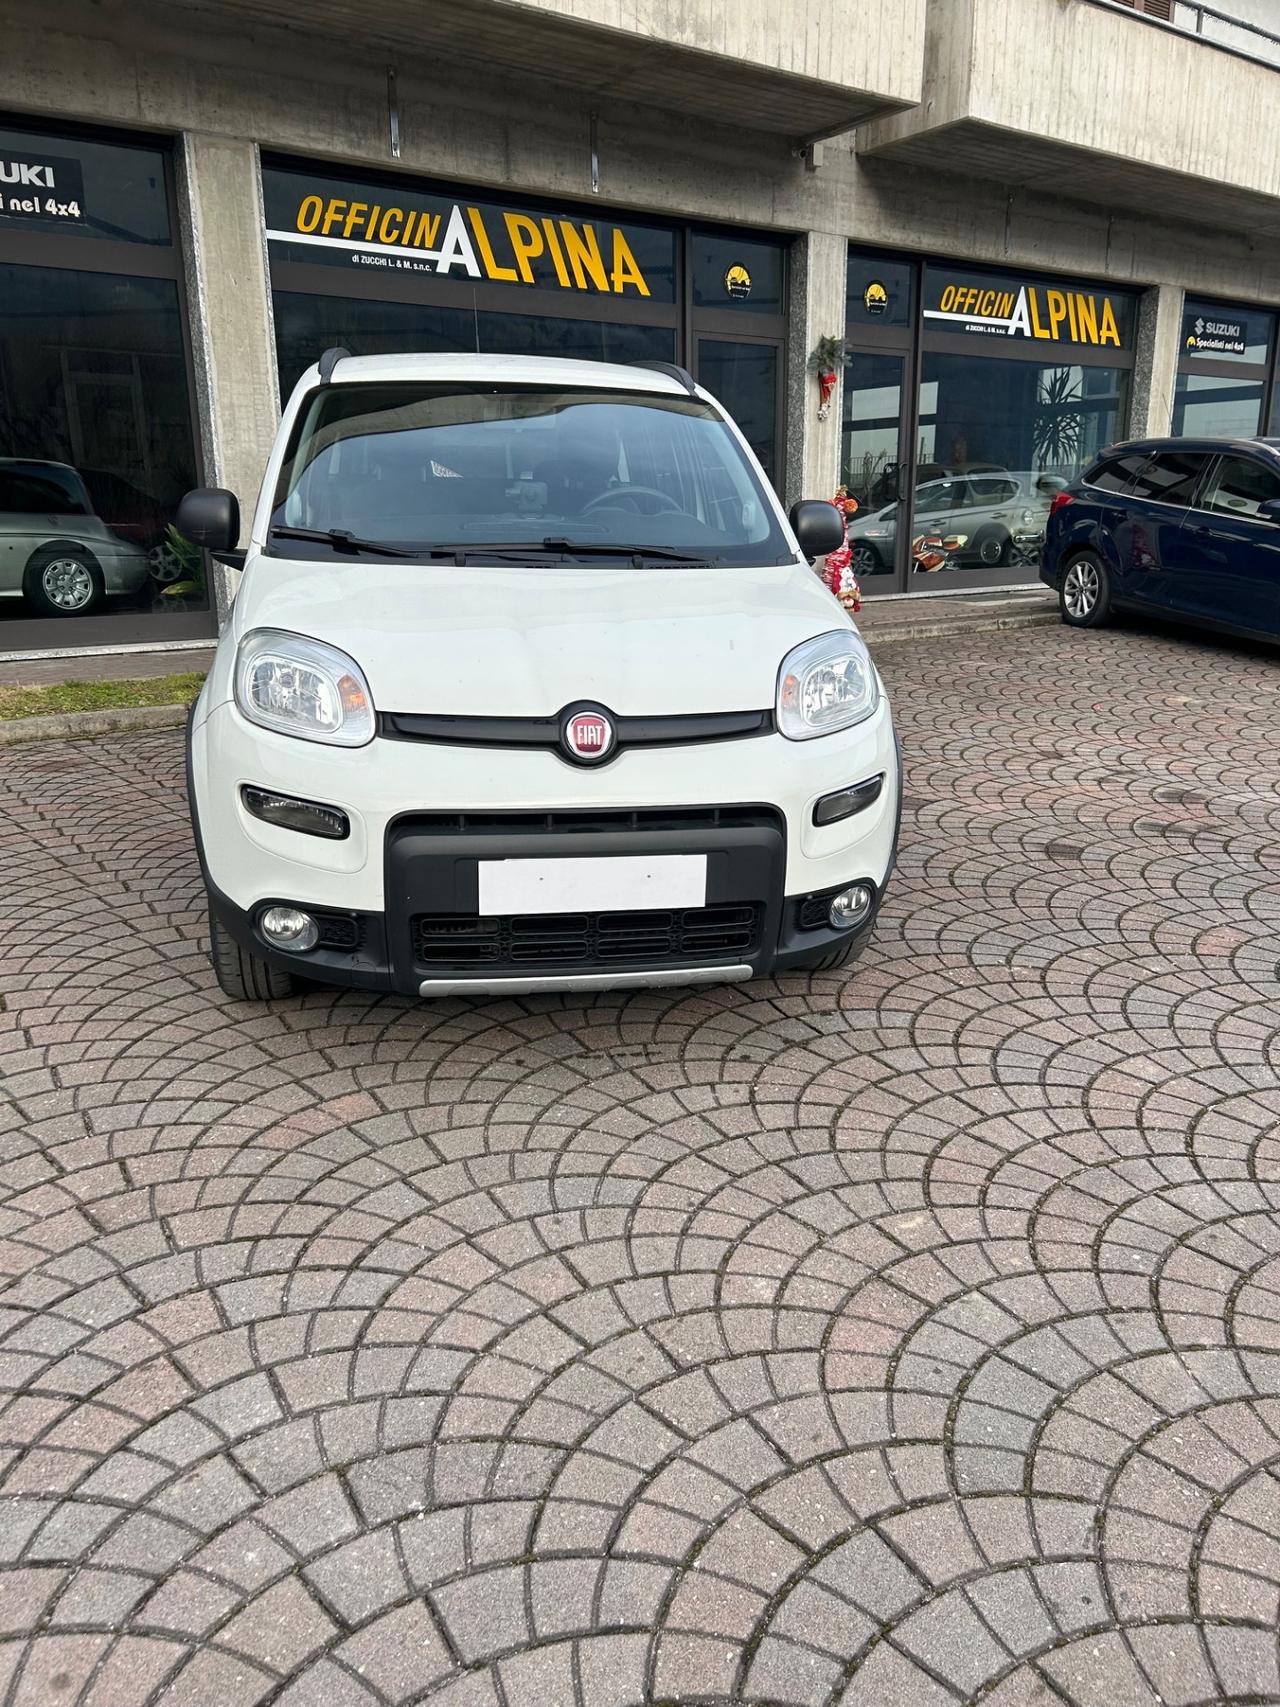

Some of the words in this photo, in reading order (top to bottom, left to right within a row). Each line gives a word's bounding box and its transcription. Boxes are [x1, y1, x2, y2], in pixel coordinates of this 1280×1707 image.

[9, 196, 41, 213] nel
[44, 198, 81, 218] 4x4
[360, 255, 387, 266] ZUCCHI
[396, 259, 402, 269] &
[403, 260, 413, 269] M.
[1205, 322, 1240, 337] SUZUKI
[577, 724, 603, 746] FIAT
